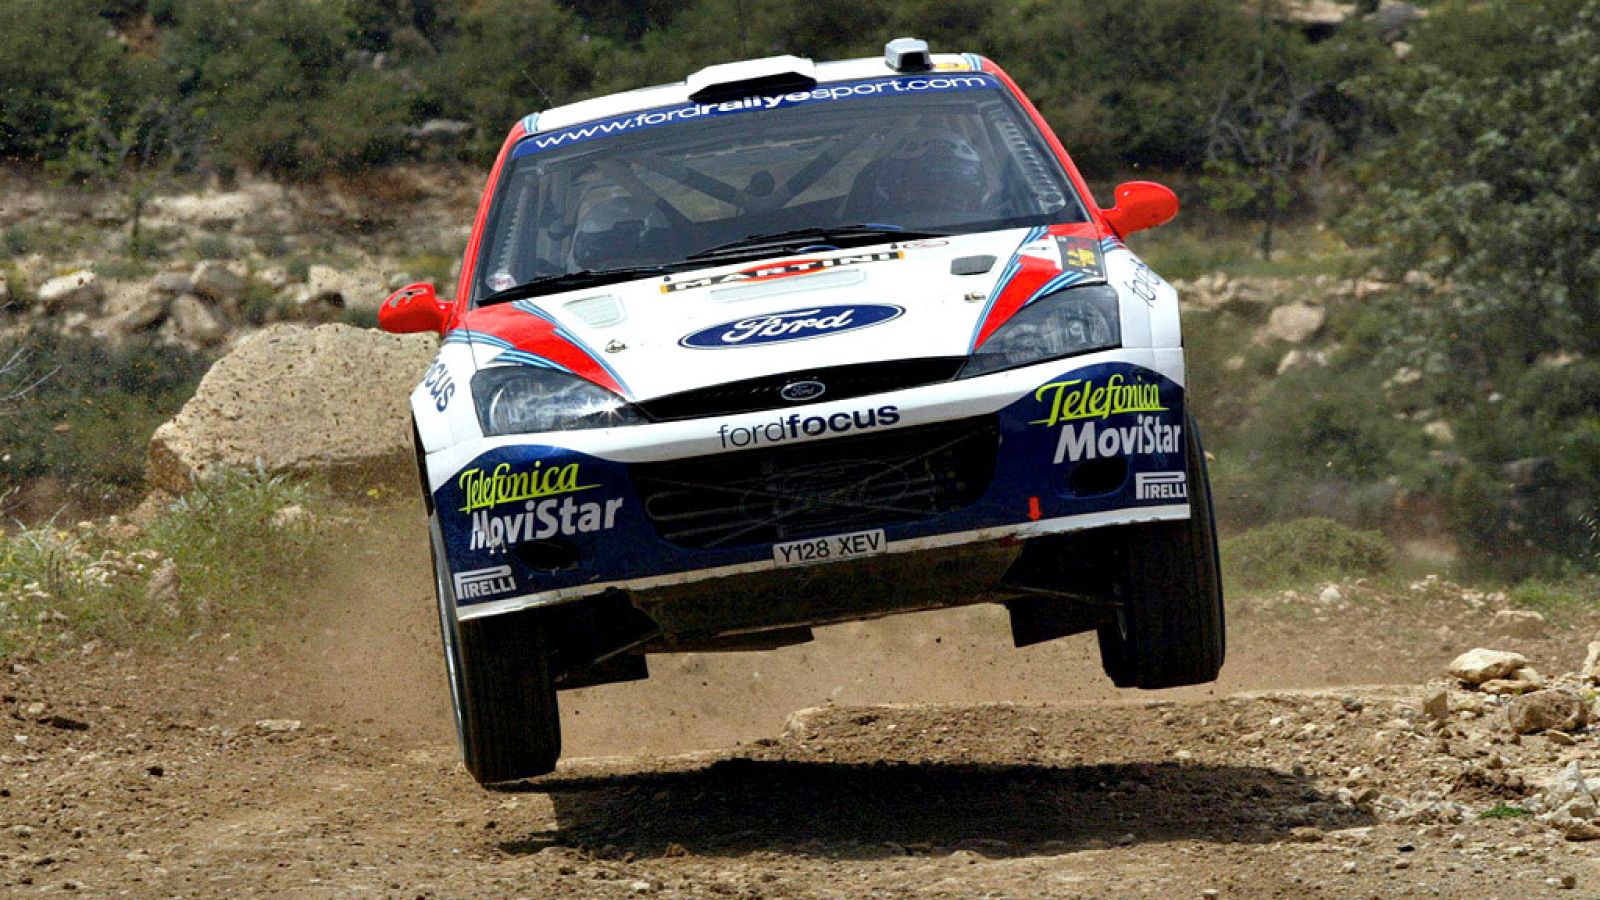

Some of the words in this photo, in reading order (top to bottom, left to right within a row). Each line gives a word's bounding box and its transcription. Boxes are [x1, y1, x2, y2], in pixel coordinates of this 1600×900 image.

[535, 75, 986, 148] www.fordrallyesport.com
[676, 252, 890, 289] MARTINI
[721, 308, 855, 343] Ford
[717, 405, 900, 449] fordfocus
[1053, 414, 1182, 464] MoviStar
[1135, 471, 1187, 500] PIRELLI
[470, 497, 624, 553] MoviStar
[779, 537, 830, 563] Y128
[838, 532, 881, 558] XEV
[454, 565, 517, 600] PIRELLI
